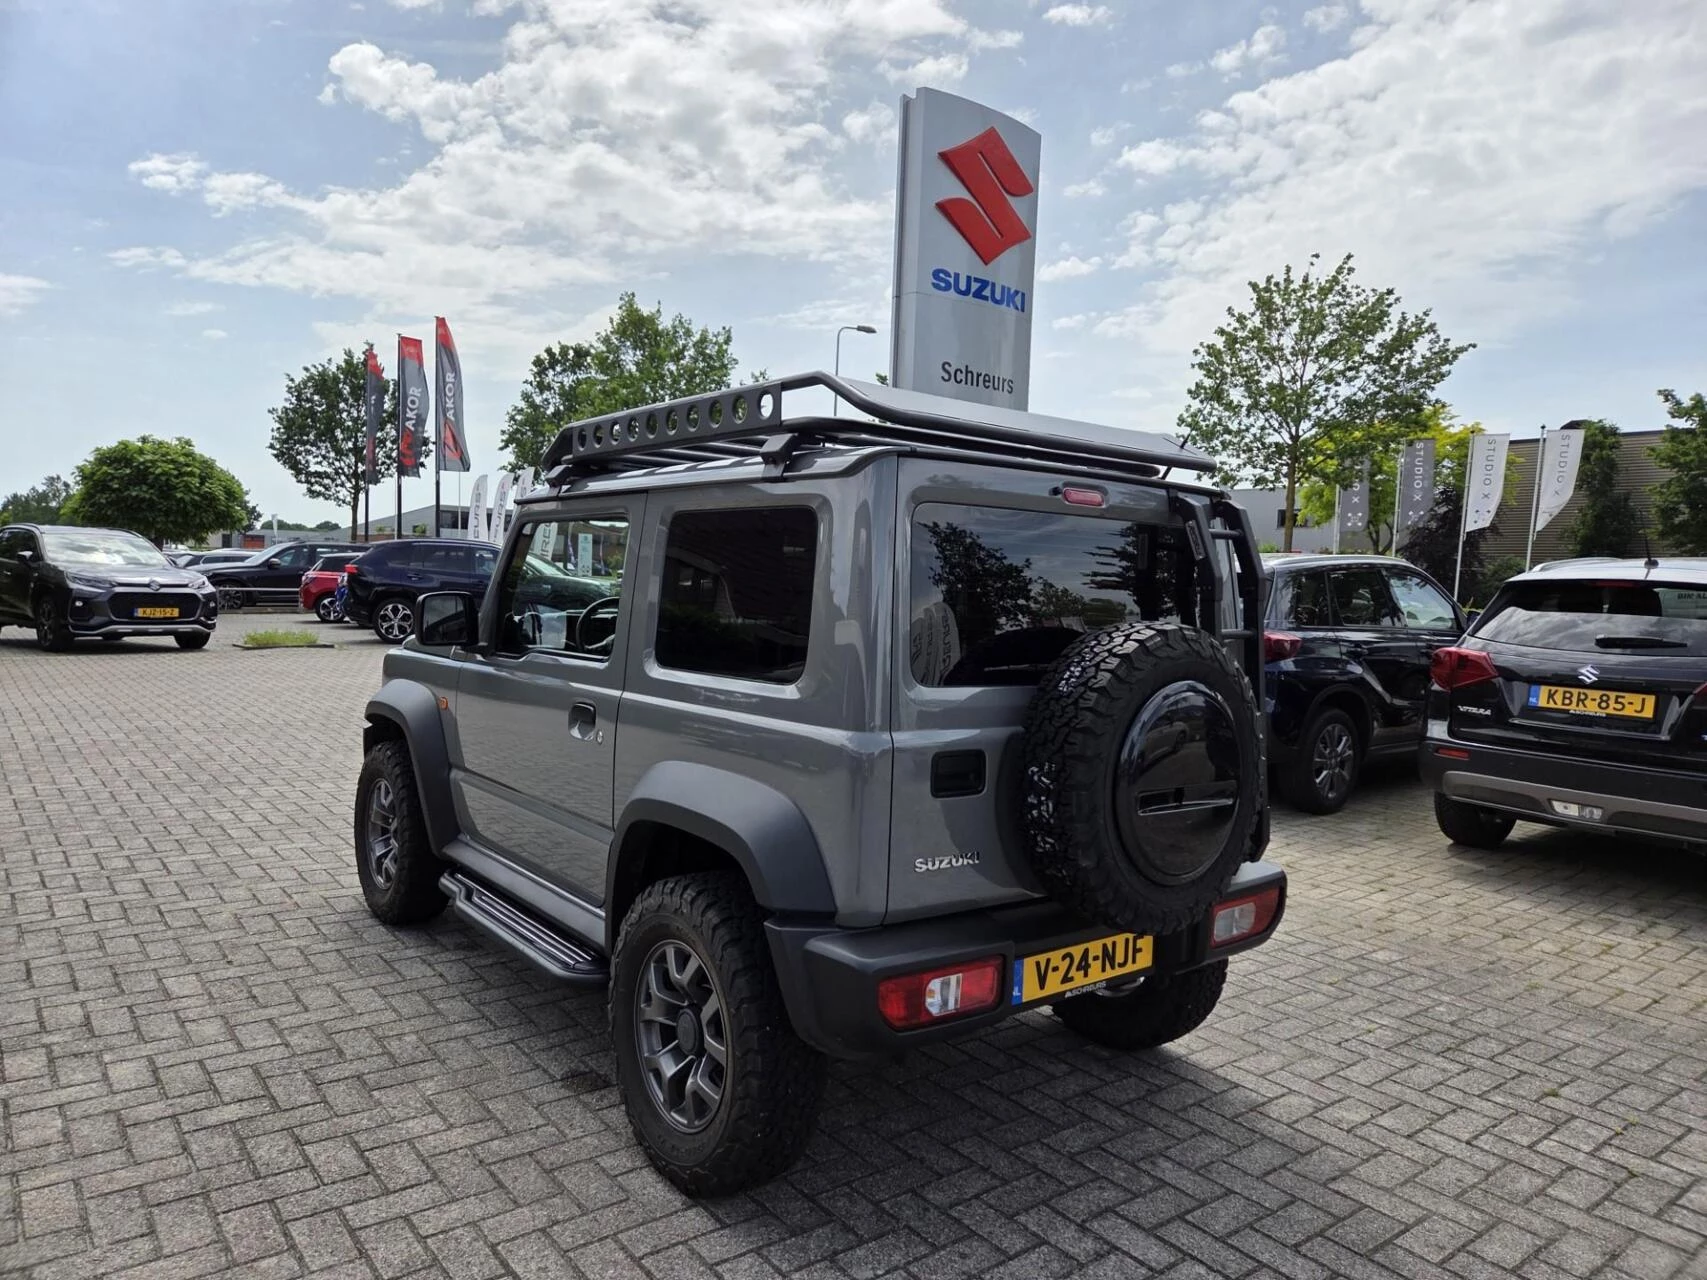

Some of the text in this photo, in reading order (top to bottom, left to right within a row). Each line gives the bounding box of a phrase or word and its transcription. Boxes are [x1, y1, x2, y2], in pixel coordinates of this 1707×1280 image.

[931, 268, 1026, 313] SUZUKI
[445, 372, 457, 422] AKOR
[941, 361, 1014, 394] Schreurs
[405, 386, 422, 431] AKOR
[1413, 442, 1424, 501] STUDIO X
[1482, 439, 1496, 500] STUDIO X
[1557, 434, 1571, 484] STUDIO
[1546, 688, 1646, 713] KBR-85-J
[914, 851, 980, 873] SUZUKI
[1035, 936, 1144, 990] V-24-NJF
